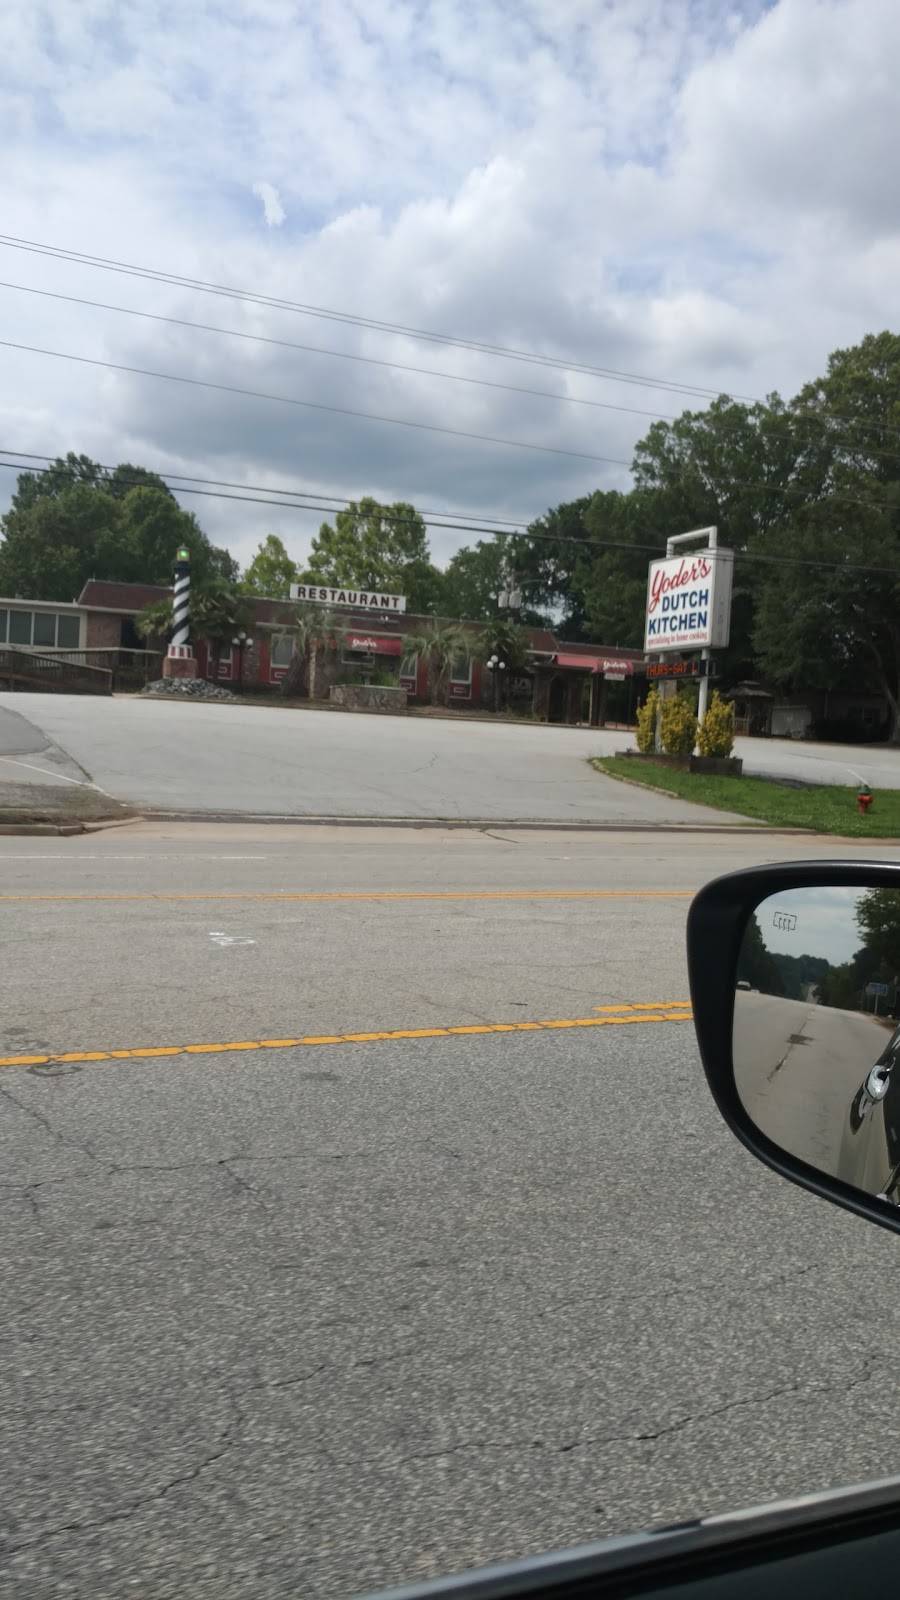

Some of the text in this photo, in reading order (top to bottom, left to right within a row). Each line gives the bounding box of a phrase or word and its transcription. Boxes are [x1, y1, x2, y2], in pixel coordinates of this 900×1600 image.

[297, 586, 399, 608] RESTAURANT
[649, 559, 711, 613] Yoder's
[661, 589, 708, 611] DUTCH
[648, 611, 707, 634] KITCHEN
